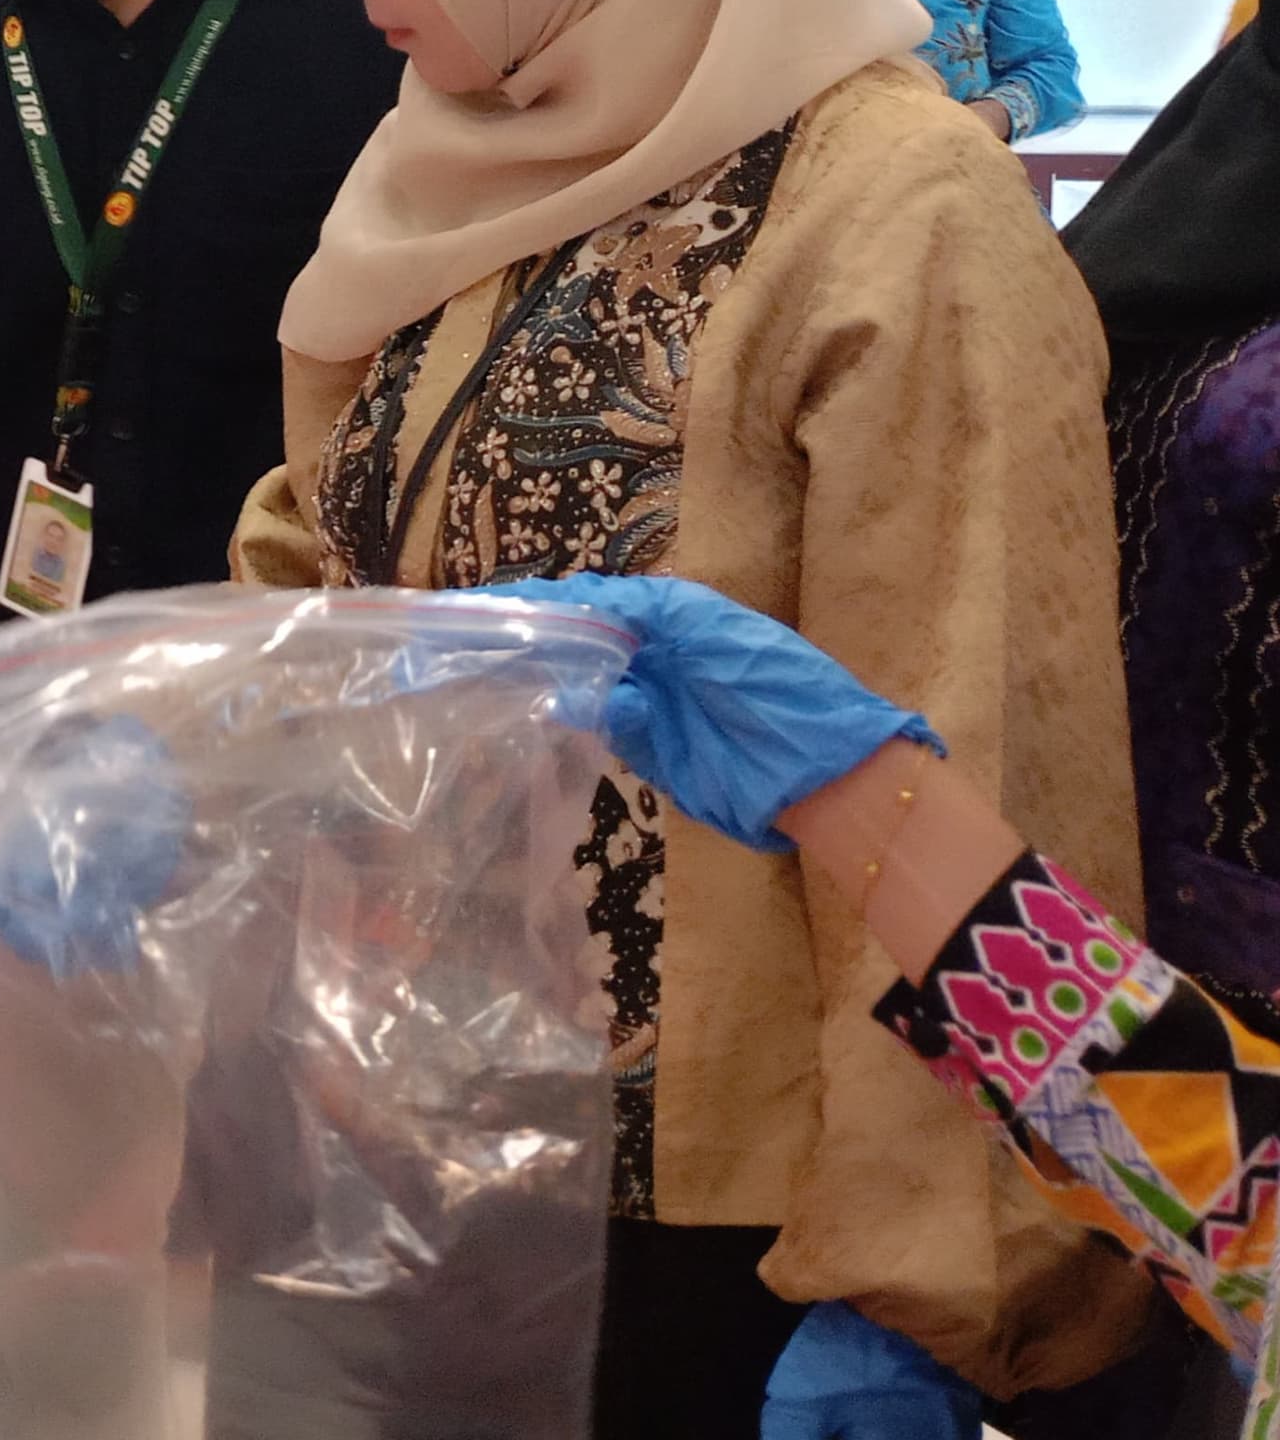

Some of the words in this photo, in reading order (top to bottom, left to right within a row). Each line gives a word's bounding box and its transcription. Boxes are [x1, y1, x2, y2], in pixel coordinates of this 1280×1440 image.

[8, 50, 33, 88] TIP
[16, 90, 47, 137] TOP
[121, 147, 152, 190] TIP
[141, 98, 175, 148] TOP
